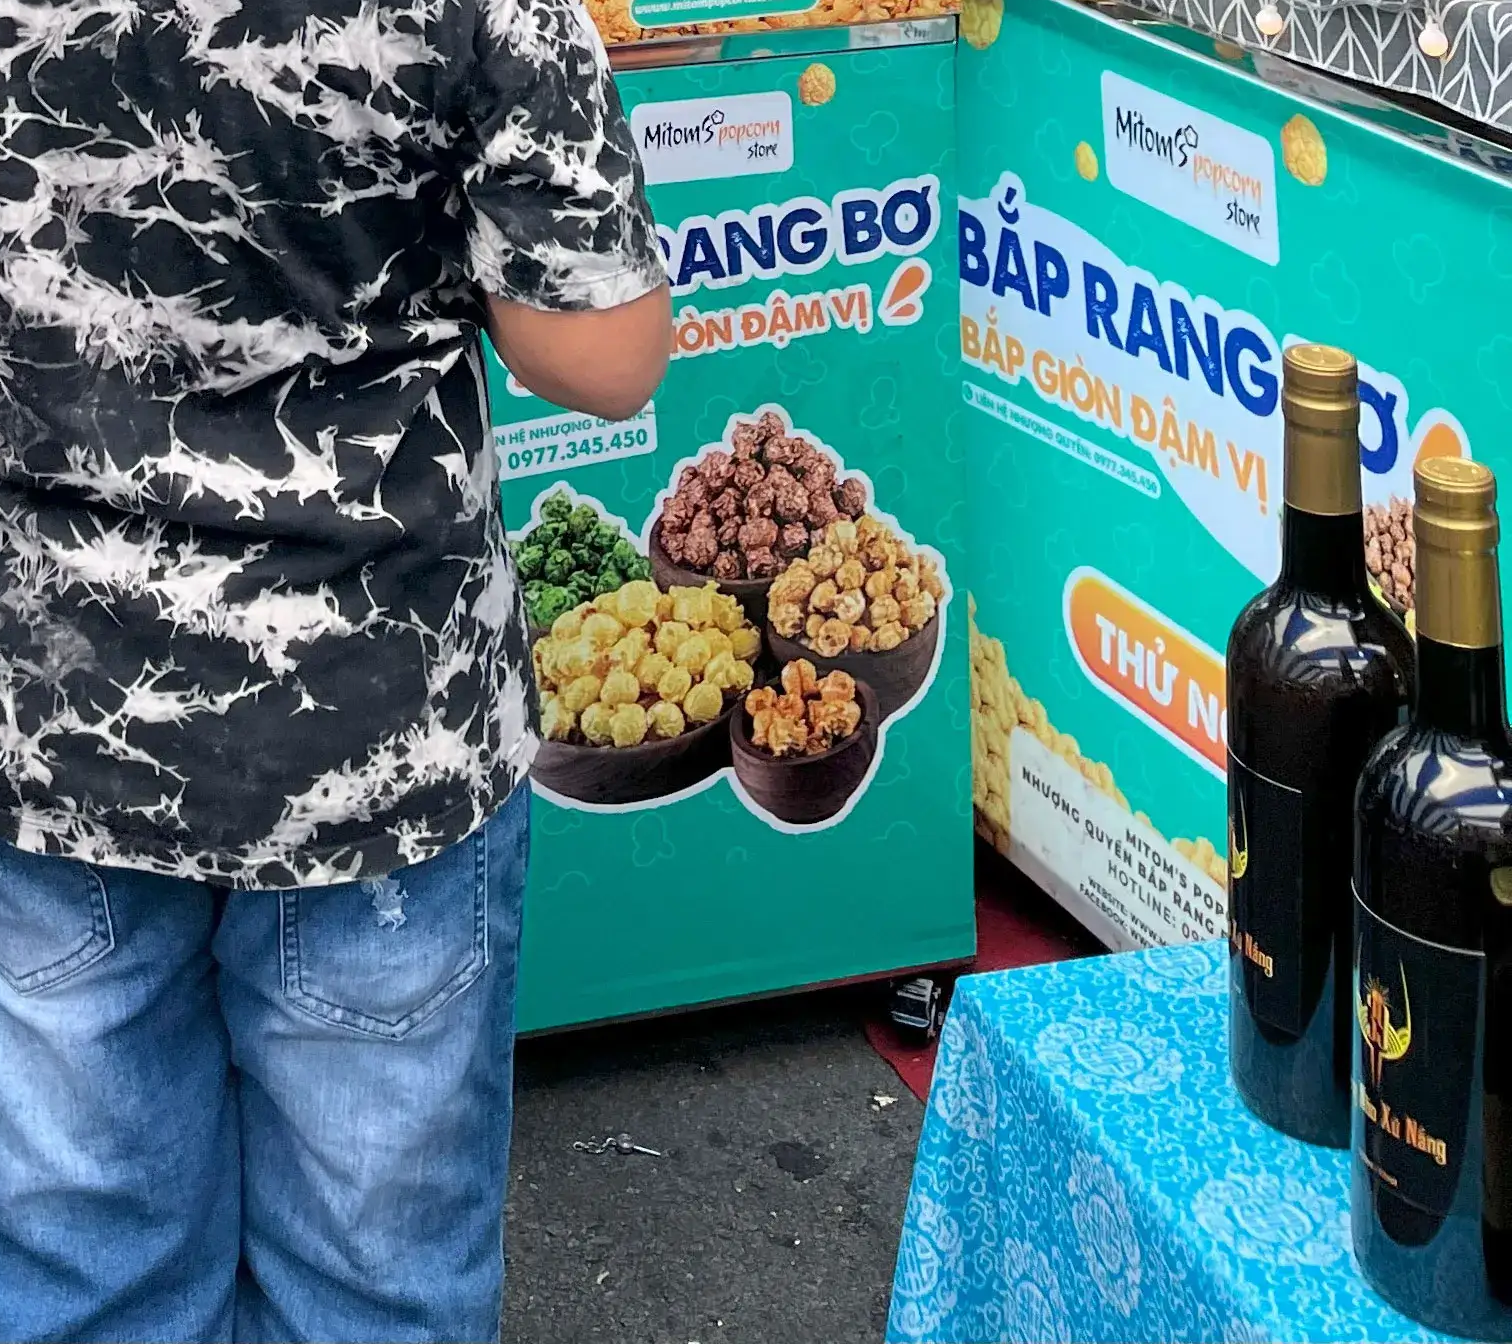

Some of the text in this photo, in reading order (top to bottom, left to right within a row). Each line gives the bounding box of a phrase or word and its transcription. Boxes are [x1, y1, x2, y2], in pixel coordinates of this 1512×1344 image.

[718, 119, 780, 148] popcorn
[747, 141, 778, 160] store
[1194, 152, 1262, 208] popcorn
[841, 185, 931, 256] BƠ
[1226, 198, 1260, 235] store
[741, 296, 825, 343] ĐẬM
[831, 291, 867, 328] VỊ
[958, 186, 1397, 474] BẮP RANG Ơ
[509, 428, 526, 445] HỆ
[529, 419, 592, 440] NHƯỢNG
[960, 305, 1269, 515] BẮP GIÒN ĐẬM VỊ
[508, 428, 648, 470] 0977.345.450
[1096, 613, 1227, 745] THỬ N
[1022, 766, 1080, 824] NHƯỢNG
[1085, 818, 1133, 868] QUYỀN
[1138, 861, 1167, 893] BẮP
[1173, 889, 1214, 935] RANG
[1126, 828, 1228, 919] MITOM'S POP
[1079, 883, 1128, 932] FACEBOOK:
[1088, 875, 1128, 917] WEBSITE:
[1107, 859, 1177, 928] HOTLINE:
[1182, 921, 1206, 941] 09
